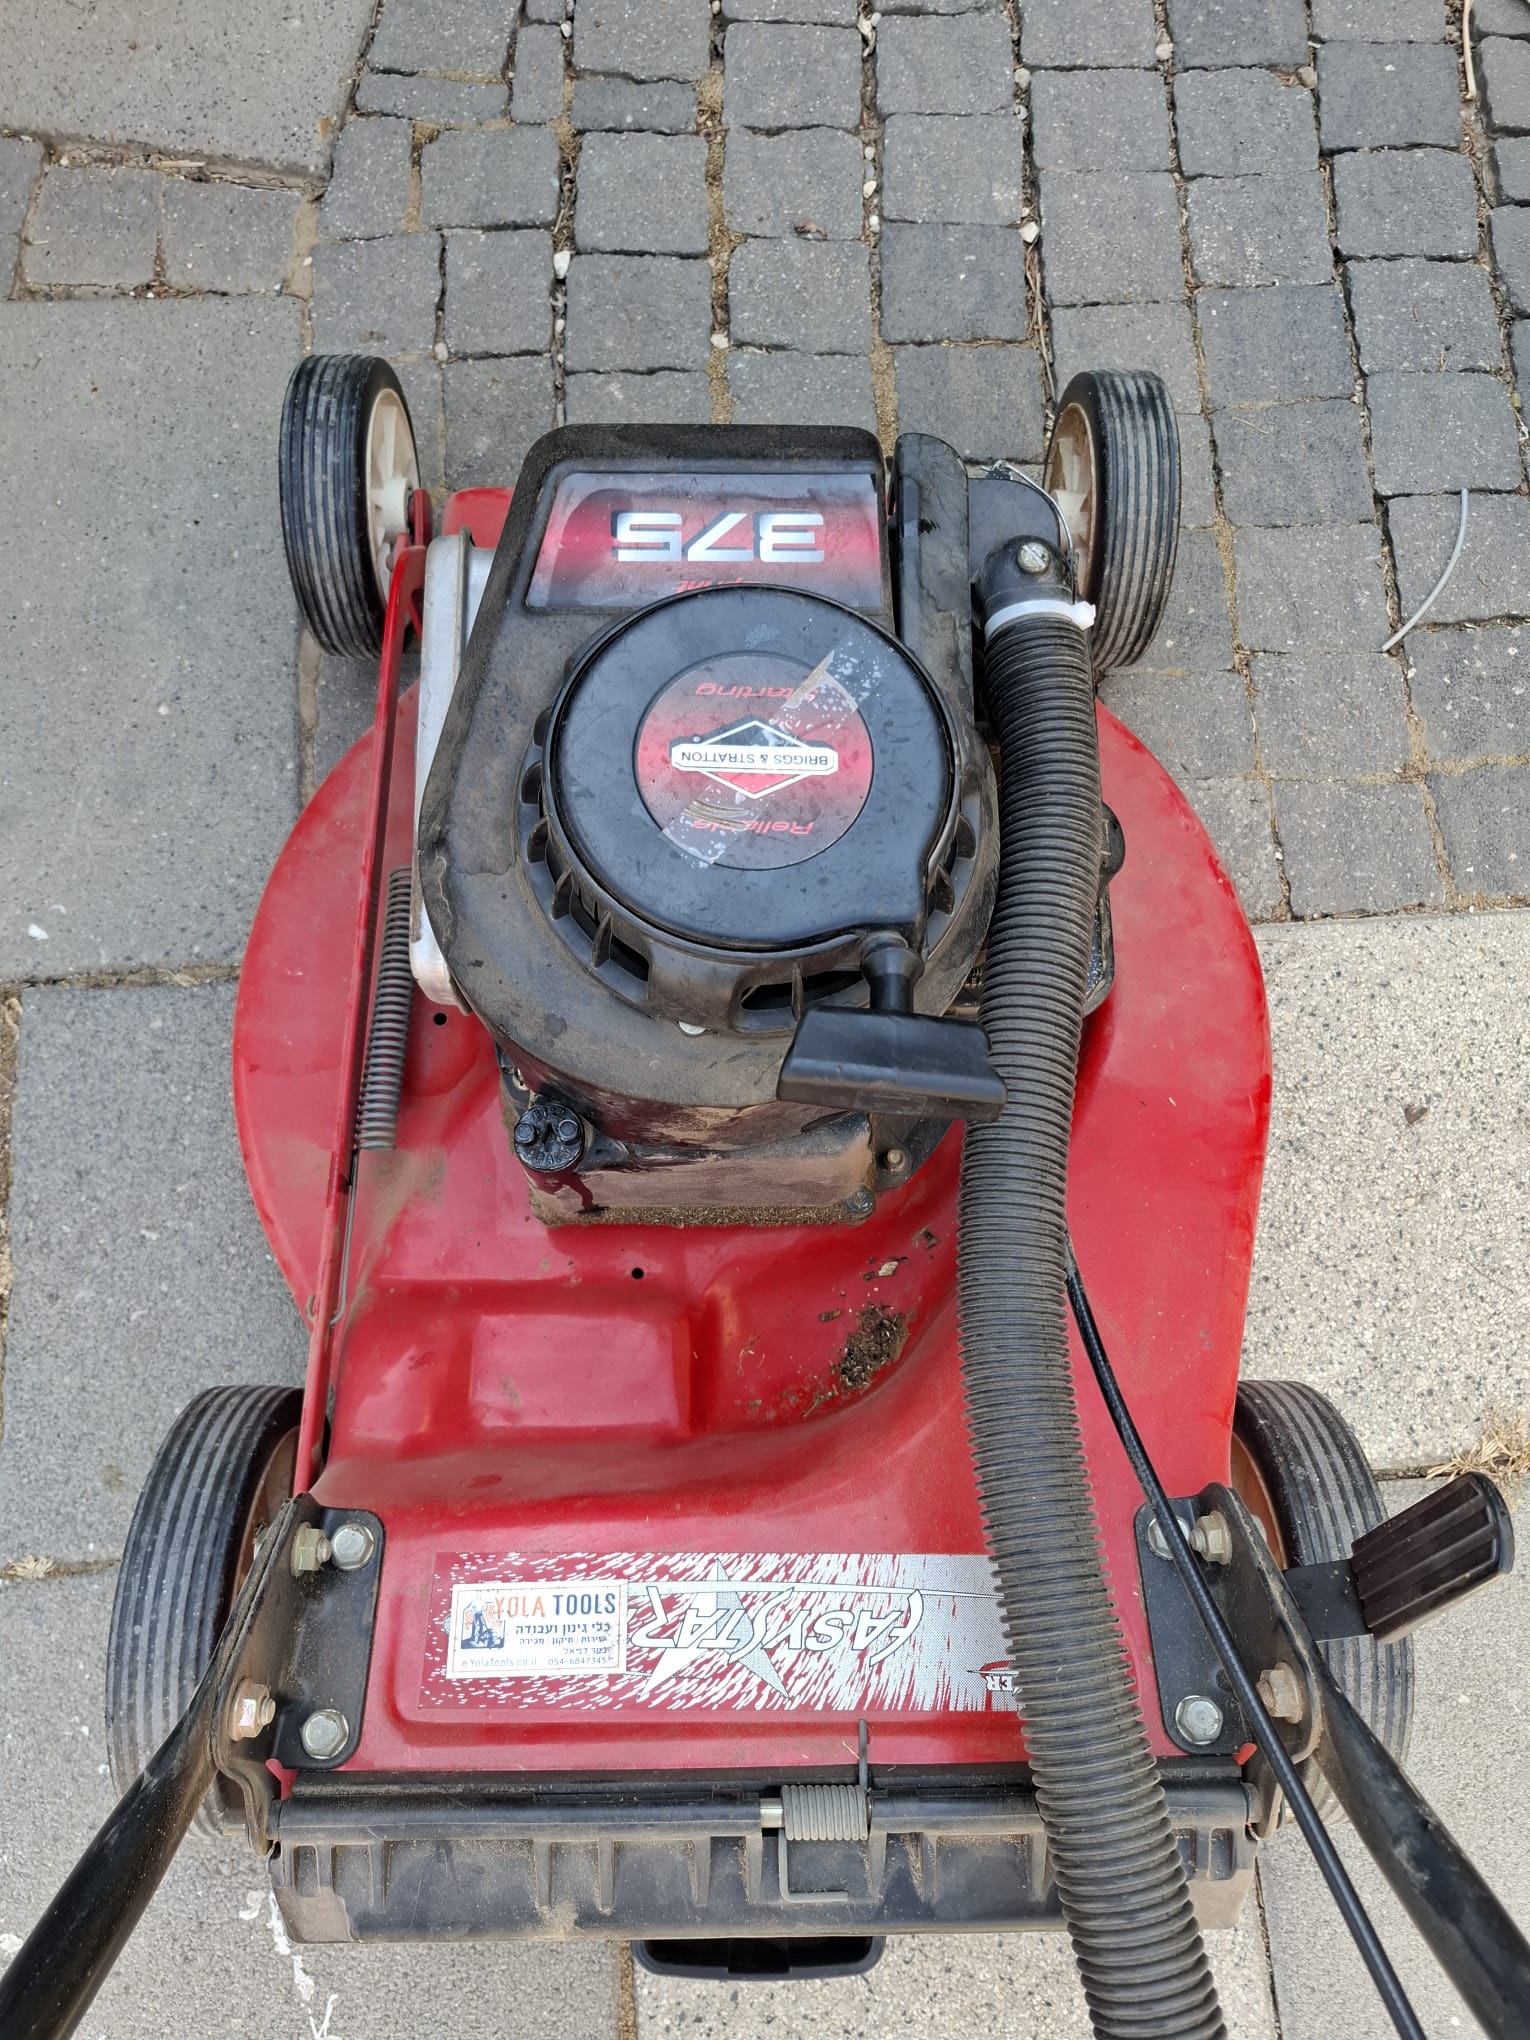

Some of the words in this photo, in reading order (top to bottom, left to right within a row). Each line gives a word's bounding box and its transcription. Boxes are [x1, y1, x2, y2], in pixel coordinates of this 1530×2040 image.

[613, 510, 826, 563] 375
[680, 751, 755, 764] STRATTON
[759, 753, 769, 764] &
[774, 753, 828, 765] BRIGGS
[495, 1595, 545, 1619] YOLA
[553, 1593, 616, 1616] TOOLS
[515, 1624, 558, 1635] ועבודה
[562, 1623, 588, 1636] גינון
[592, 1621, 611, 1633] כלי
